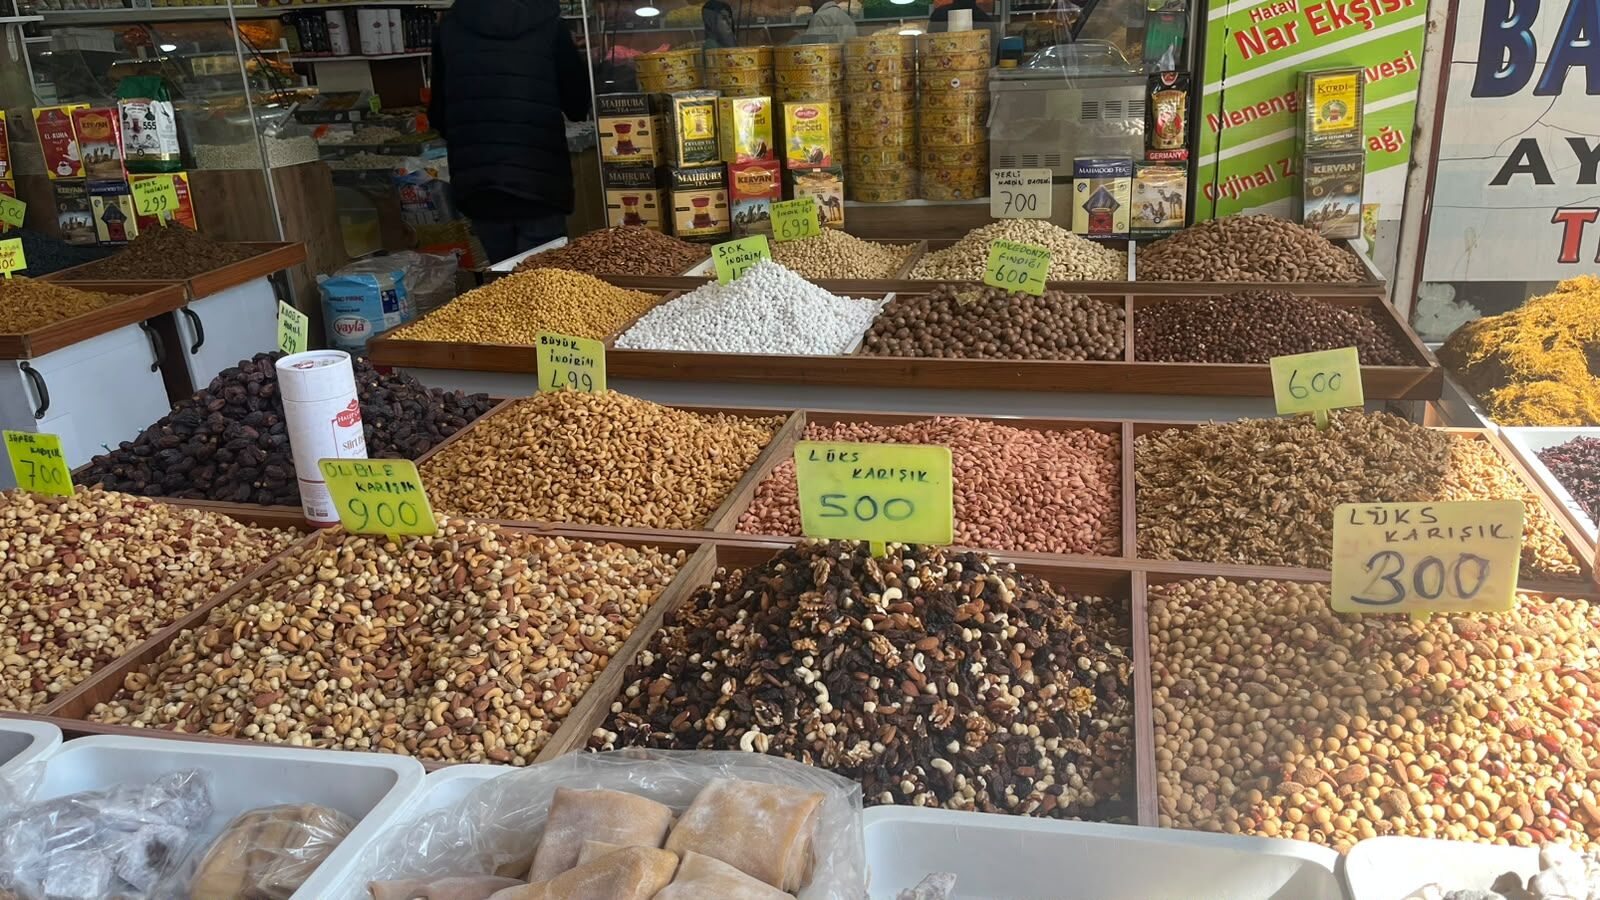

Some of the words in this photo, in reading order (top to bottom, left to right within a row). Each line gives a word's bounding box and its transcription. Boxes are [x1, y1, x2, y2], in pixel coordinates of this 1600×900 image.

[1249, 1, 1298, 23] Hatay
[1234, 21, 1297, 59] Nar
[1304, 0, 1413, 36] Ekşisi
[1206, 92, 1298, 131] Meneng
[1364, 51, 1414, 84] vesi
[601, 99, 643, 108] MAHBUBA
[1150, 152, 1183, 160] GERMANY
[609, 171, 650, 181] MAHBUBA
[678, 170, 722, 182] MAHBUBA
[1313, 163, 1355, 173] KERVAN
[737, 174, 772, 184] KERVAN
[1203, 163, 1274, 200] Orjinal
[1277, 159, 1296, 178] Z
[144, 195, 167, 213] 299
[1000, 191, 1036, 214] 700
[782, 219, 809, 238] 699
[1551, 207, 1600, 263] T
[993, 241, 1050, 259] MAKEDONYA
[0, 259, 15, 269] 00
[999, 254, 1041, 269] FINDIĞI
[336, 320, 364, 334] yayla
[283, 333, 296, 354] 299
[541, 336, 580, 351] BÜYÜK
[1289, 370, 1341, 399] 600
[9, 435, 35, 443] SÜPER
[809, 450, 859, 462] LÜKS
[20, 460, 62, 487] 700
[852, 467, 928, 483] KARIŞIK
[348, 498, 418, 530] 900
[819, 494, 914, 521] 500
[1350, 507, 1438, 525] LÜKS
[1385, 524, 1508, 542] KARIŞIK
[1350, 551, 1490, 605] 300
